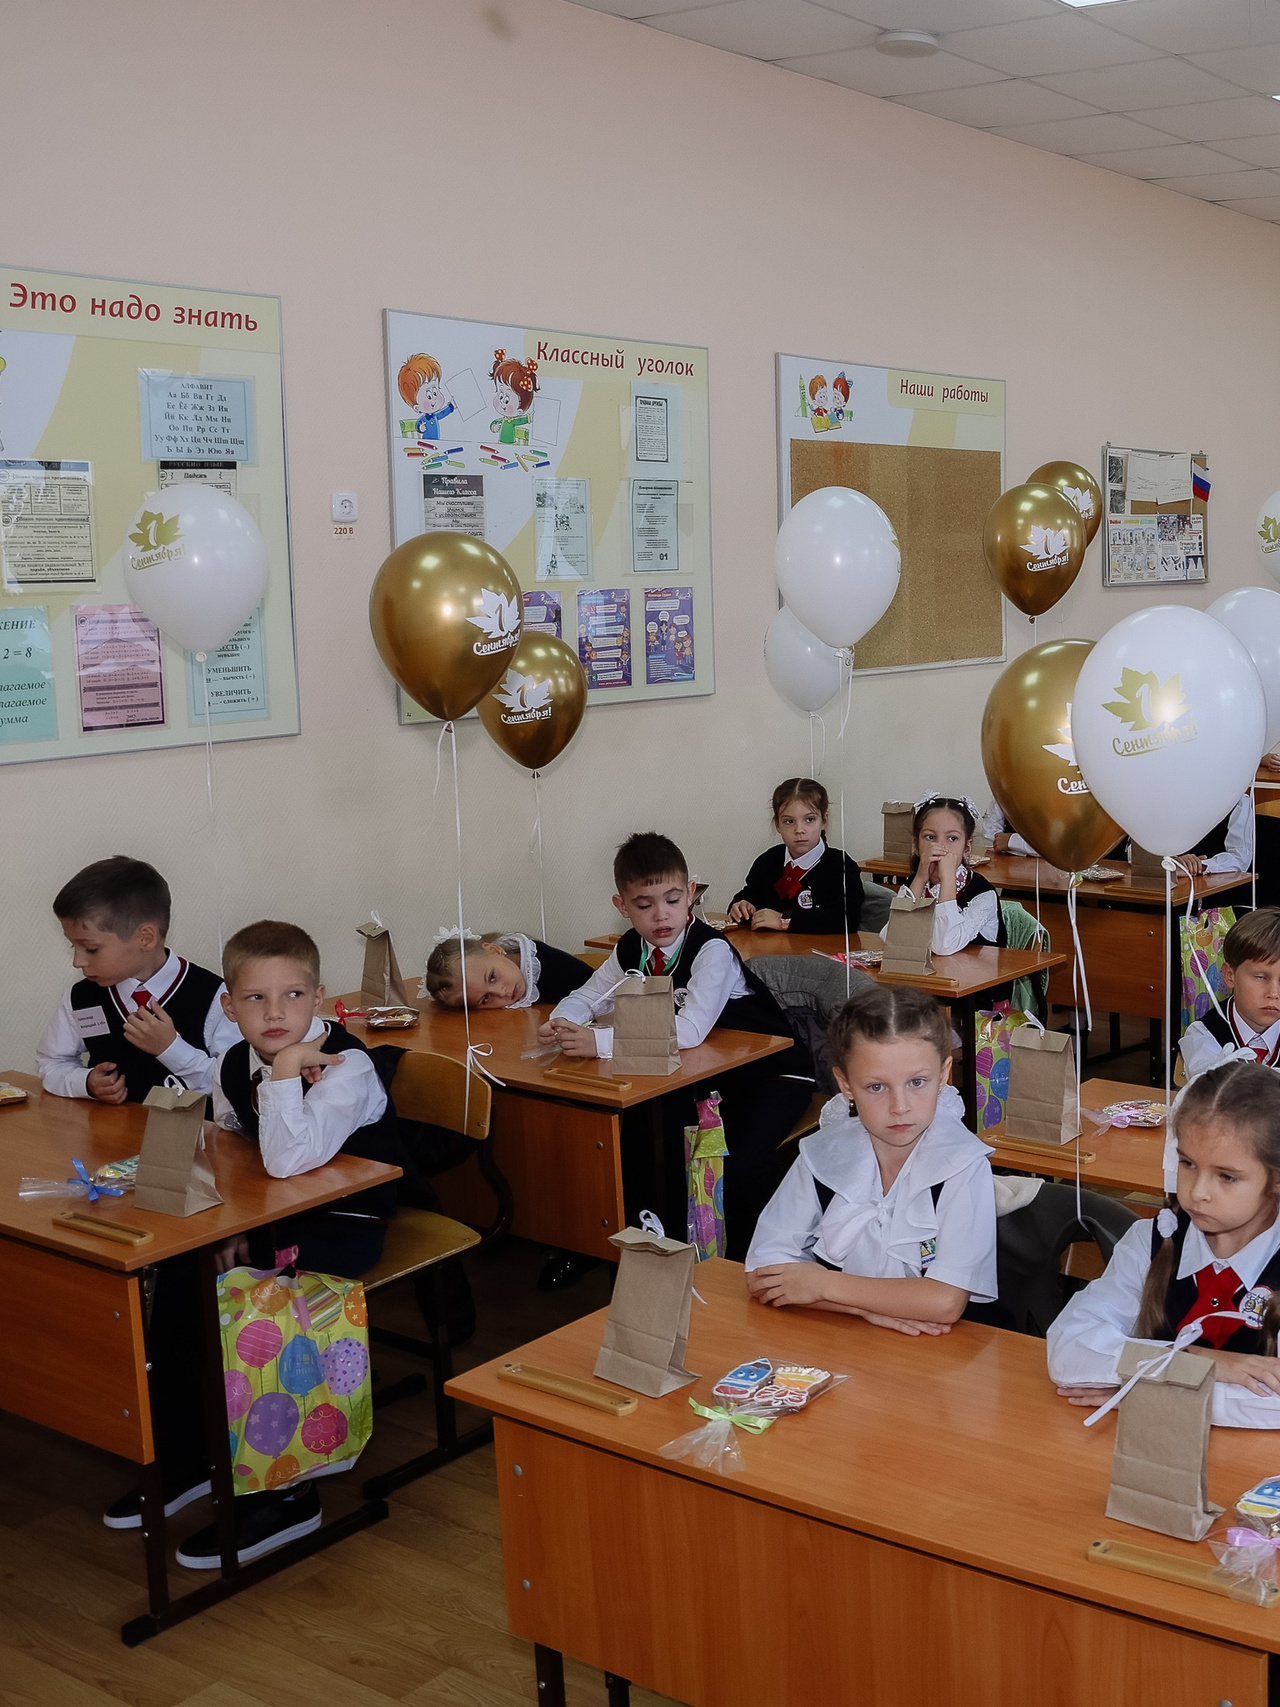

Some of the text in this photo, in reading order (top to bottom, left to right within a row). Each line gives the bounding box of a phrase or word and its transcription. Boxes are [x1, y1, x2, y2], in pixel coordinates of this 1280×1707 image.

[8, 282, 258, 331] Это надо знать
[536, 341, 695, 377] Классный уголок
[180, 383, 213, 391] АЛФАВИТ
[900, 379, 988, 402] Наши работы
[334, 527, 348, 535] 220
[659, 553, 668, 561] 01
[0, 620, 36, 630] ЕНИЕ
[3, 648, 10, 659] 2
[25, 646, 32, 658] 8
[207, 665, 252, 674] УМЕНЬШИТЬ
[210, 688, 252, 698] УВЕЛИЧИТЬ
[501, 707, 552, 725] Сентября!
